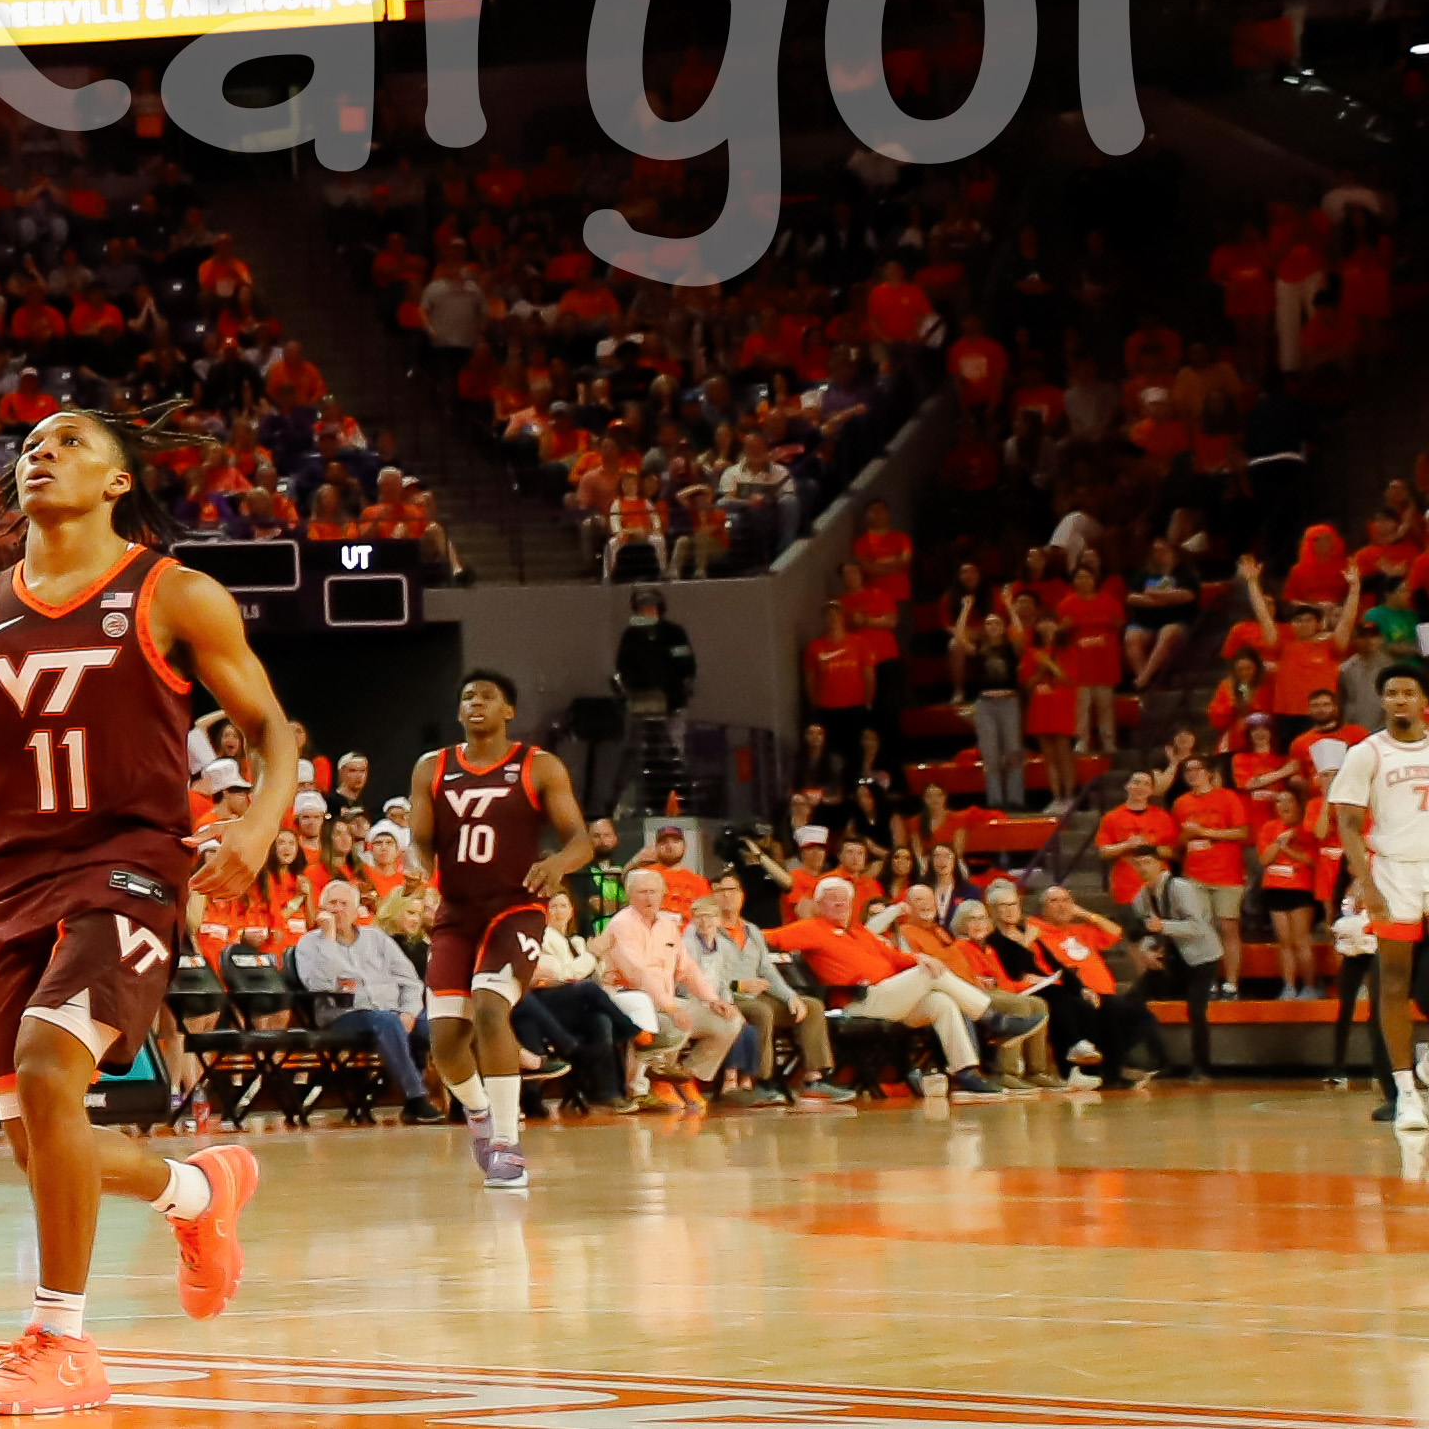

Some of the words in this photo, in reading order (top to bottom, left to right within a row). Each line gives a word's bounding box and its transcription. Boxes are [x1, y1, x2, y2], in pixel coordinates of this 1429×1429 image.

[25, 727, 91, 813] 11
[444, 787, 512, 818] VT
[456, 823, 496, 865] 10
[113, 913, 170, 977] VT
